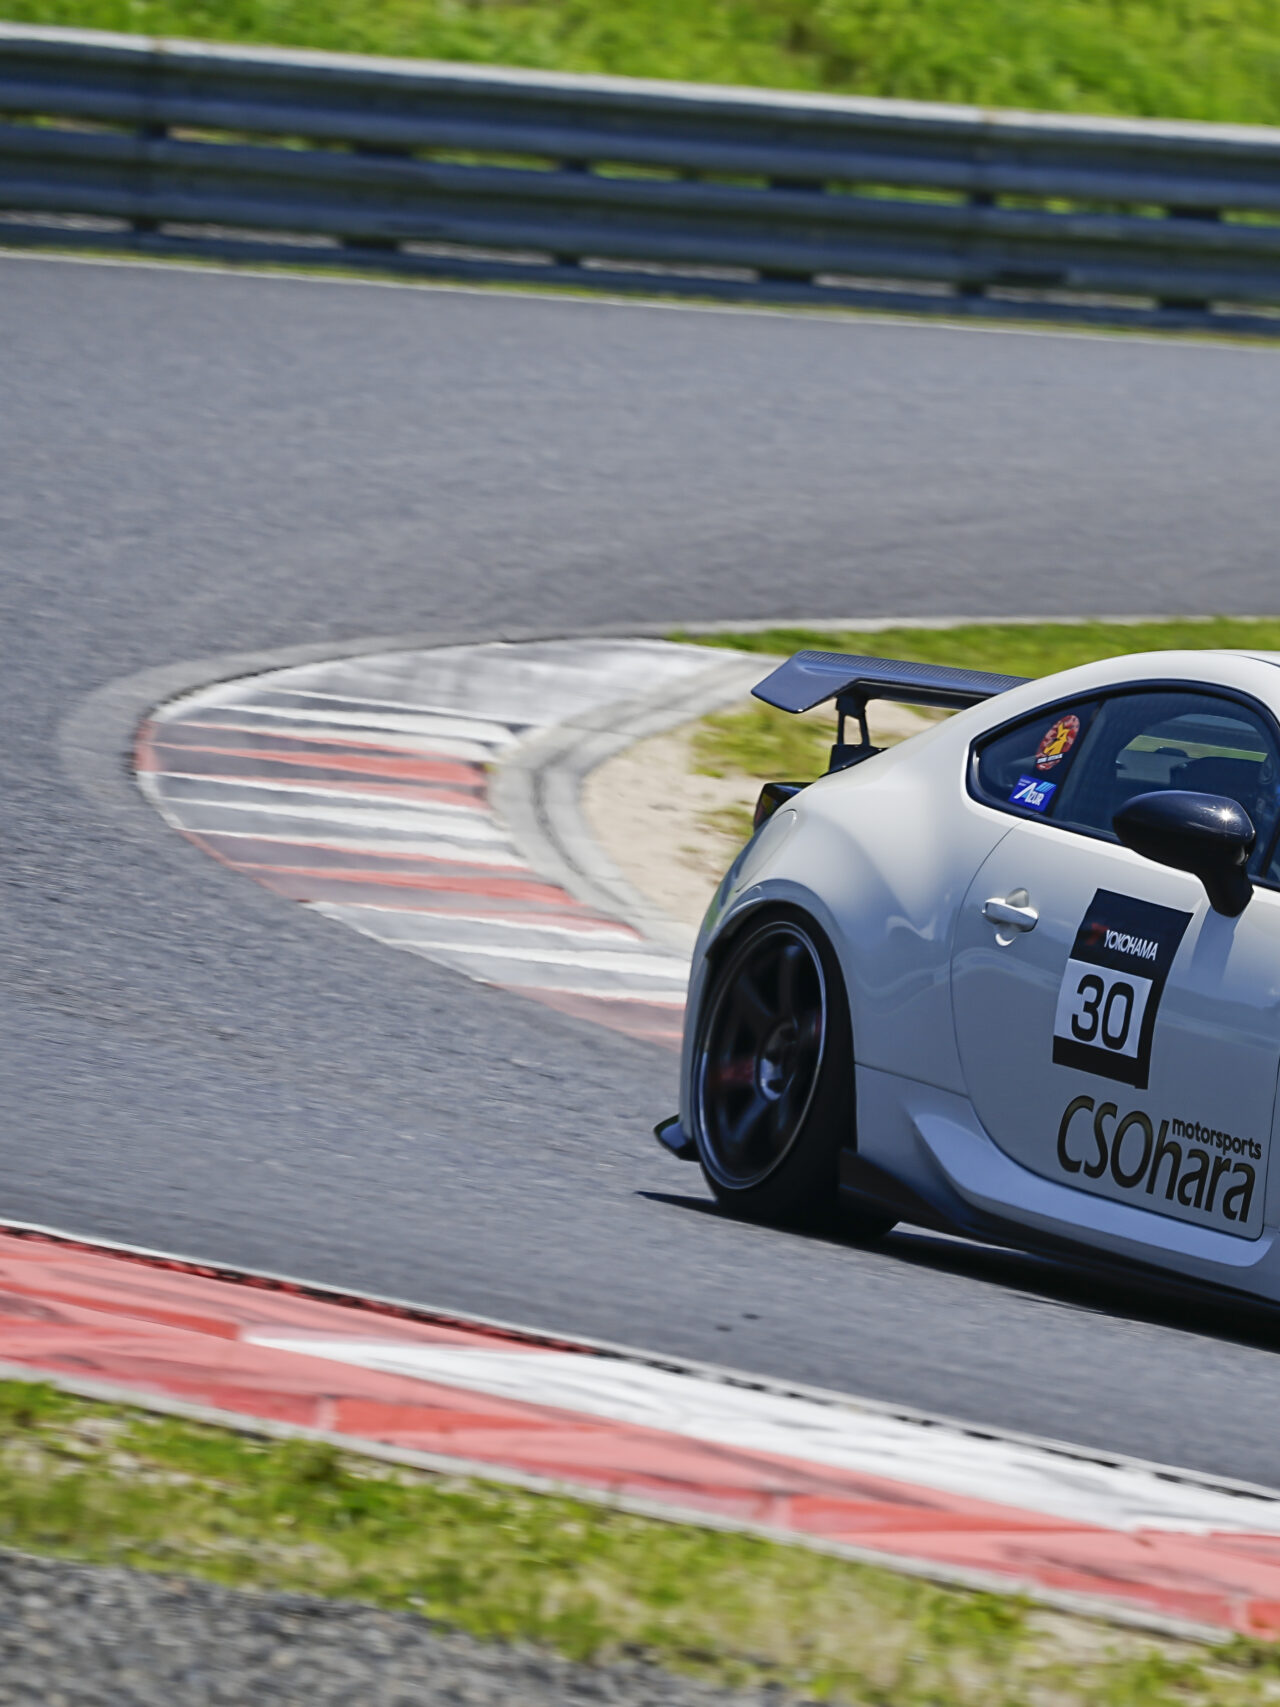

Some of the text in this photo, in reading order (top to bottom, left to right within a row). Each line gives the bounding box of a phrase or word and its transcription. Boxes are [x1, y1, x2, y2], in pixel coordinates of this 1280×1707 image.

[1104, 929, 1158, 961] YOKOHAMA
[1071, 973, 1135, 1051] 30
[1172, 1118, 1262, 1160] motorsports
